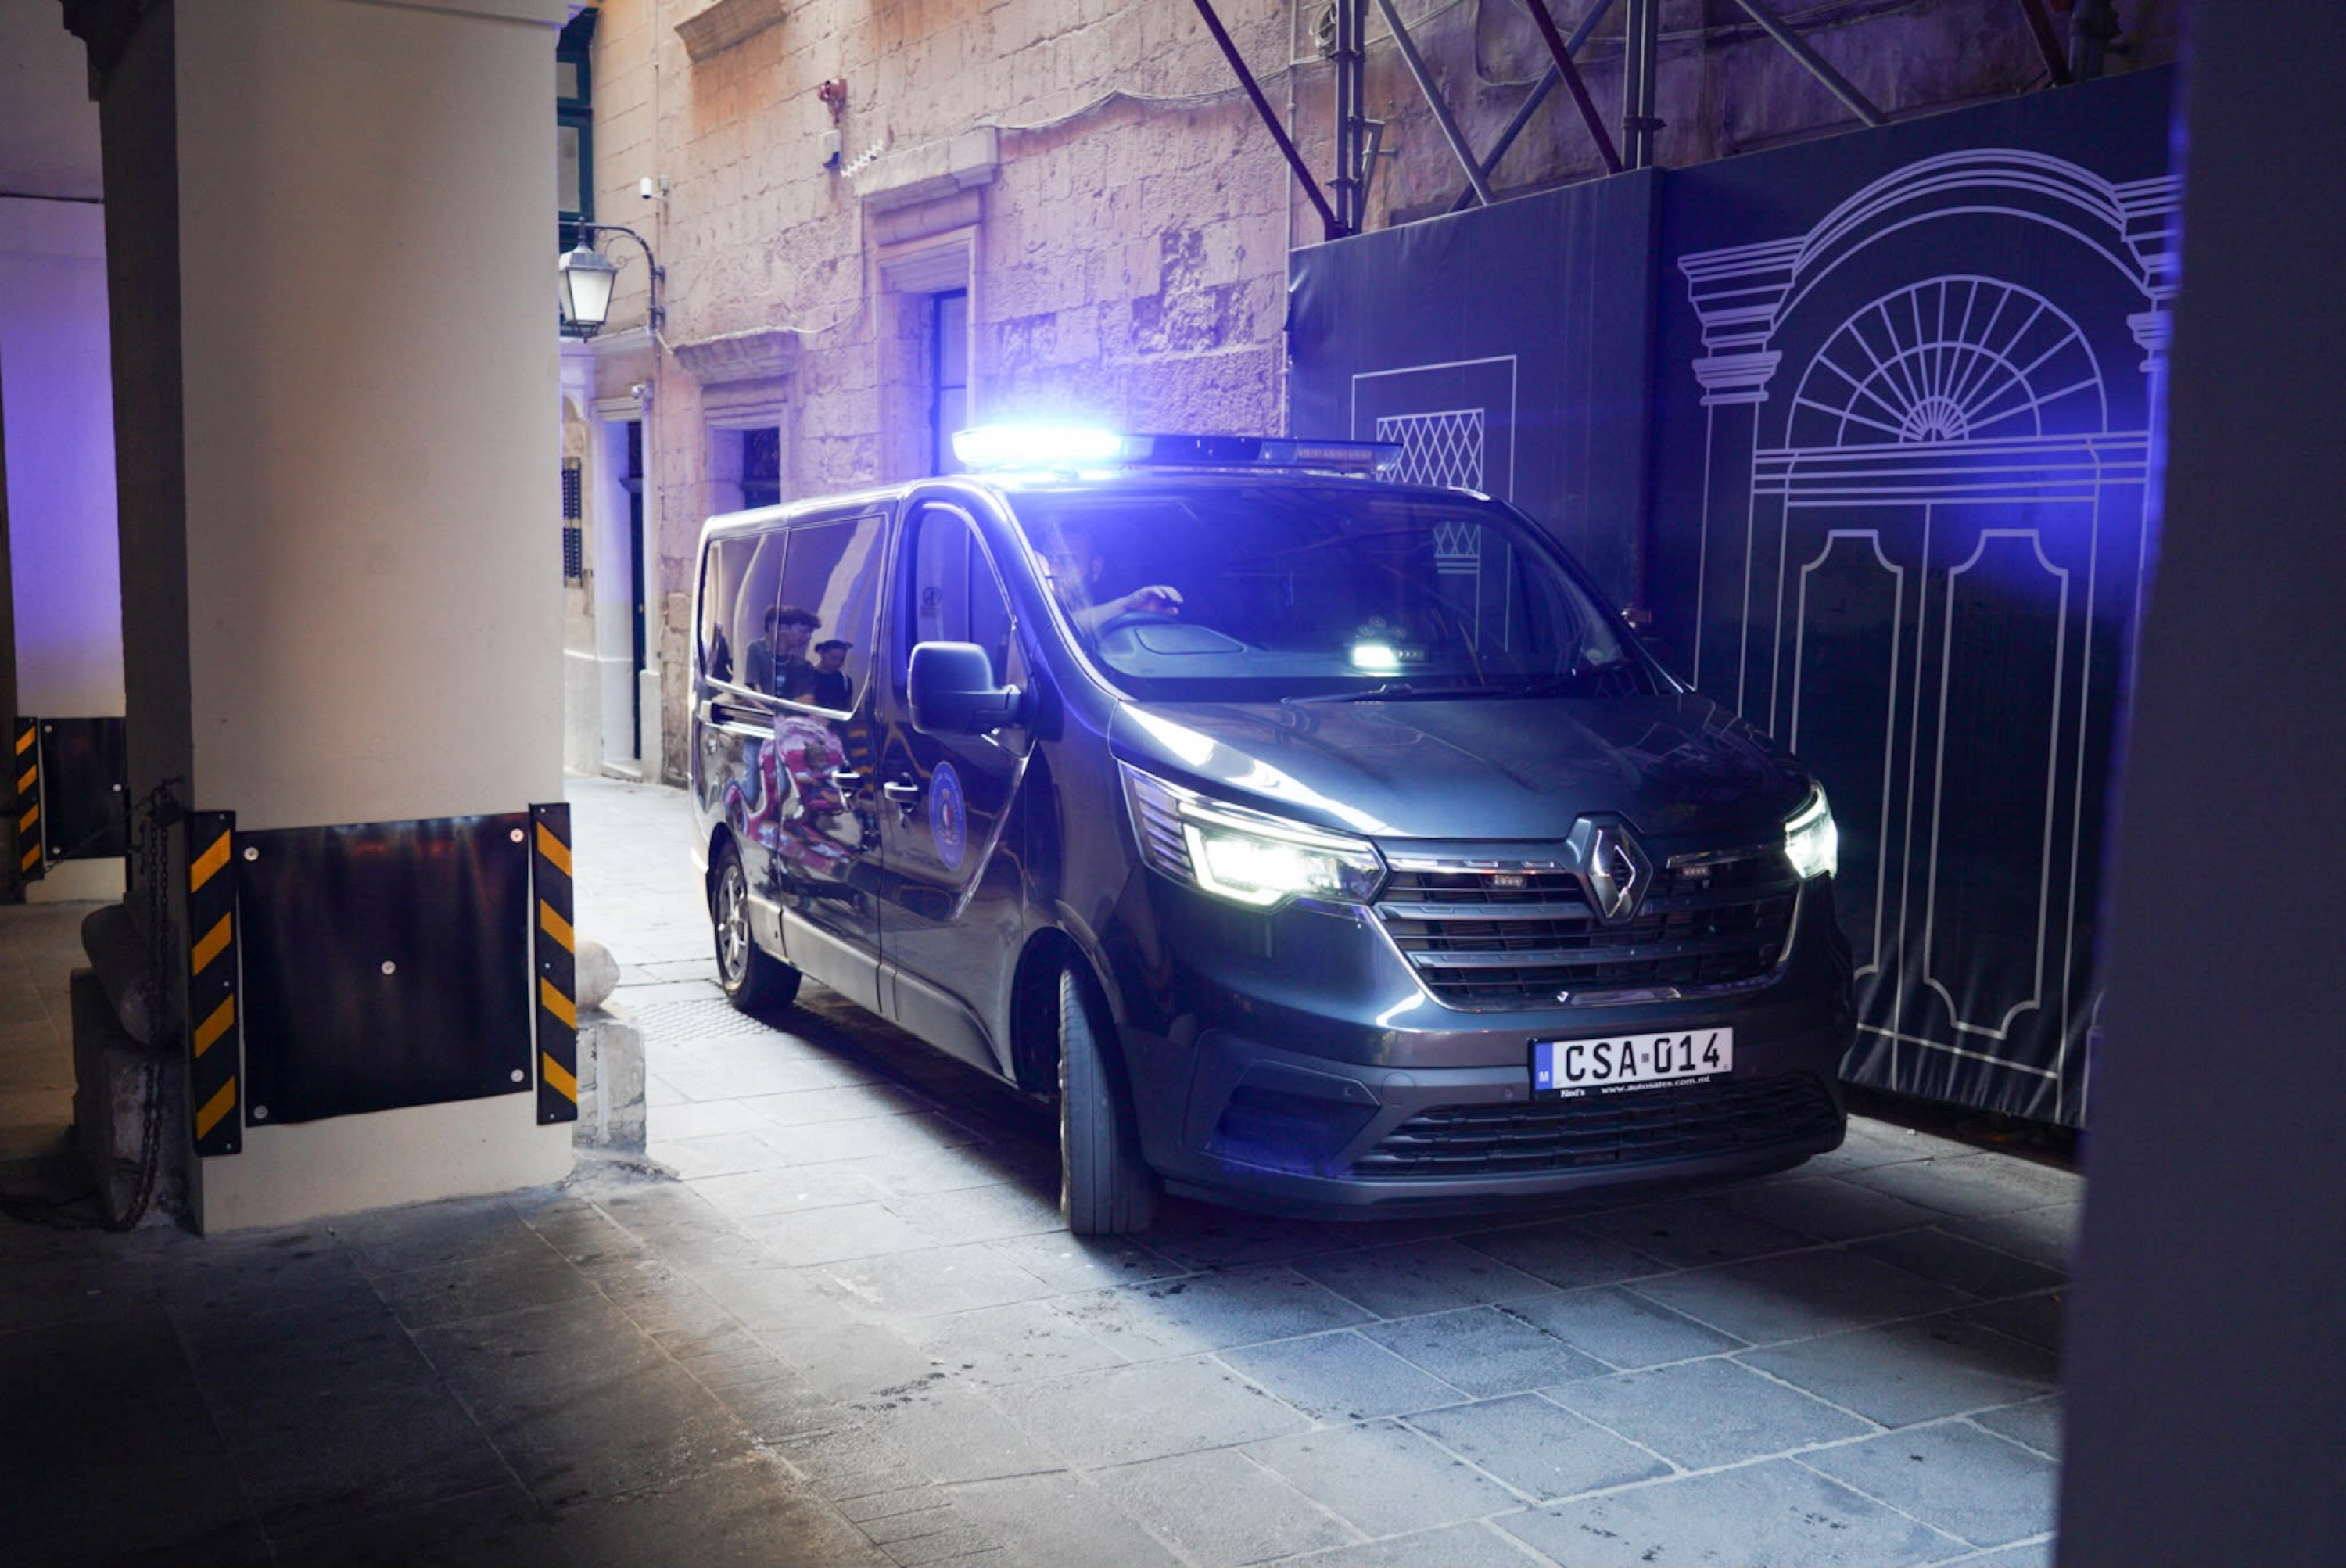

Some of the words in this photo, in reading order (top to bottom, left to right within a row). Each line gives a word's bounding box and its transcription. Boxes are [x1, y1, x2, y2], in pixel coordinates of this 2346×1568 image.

[1566, 1040, 1637, 1082] CSA
[1654, 1032, 1720, 1074] 014
[1538, 1070, 1550, 1083] M
[1601, 1075, 1711, 1094] www.autosales.com.mt
